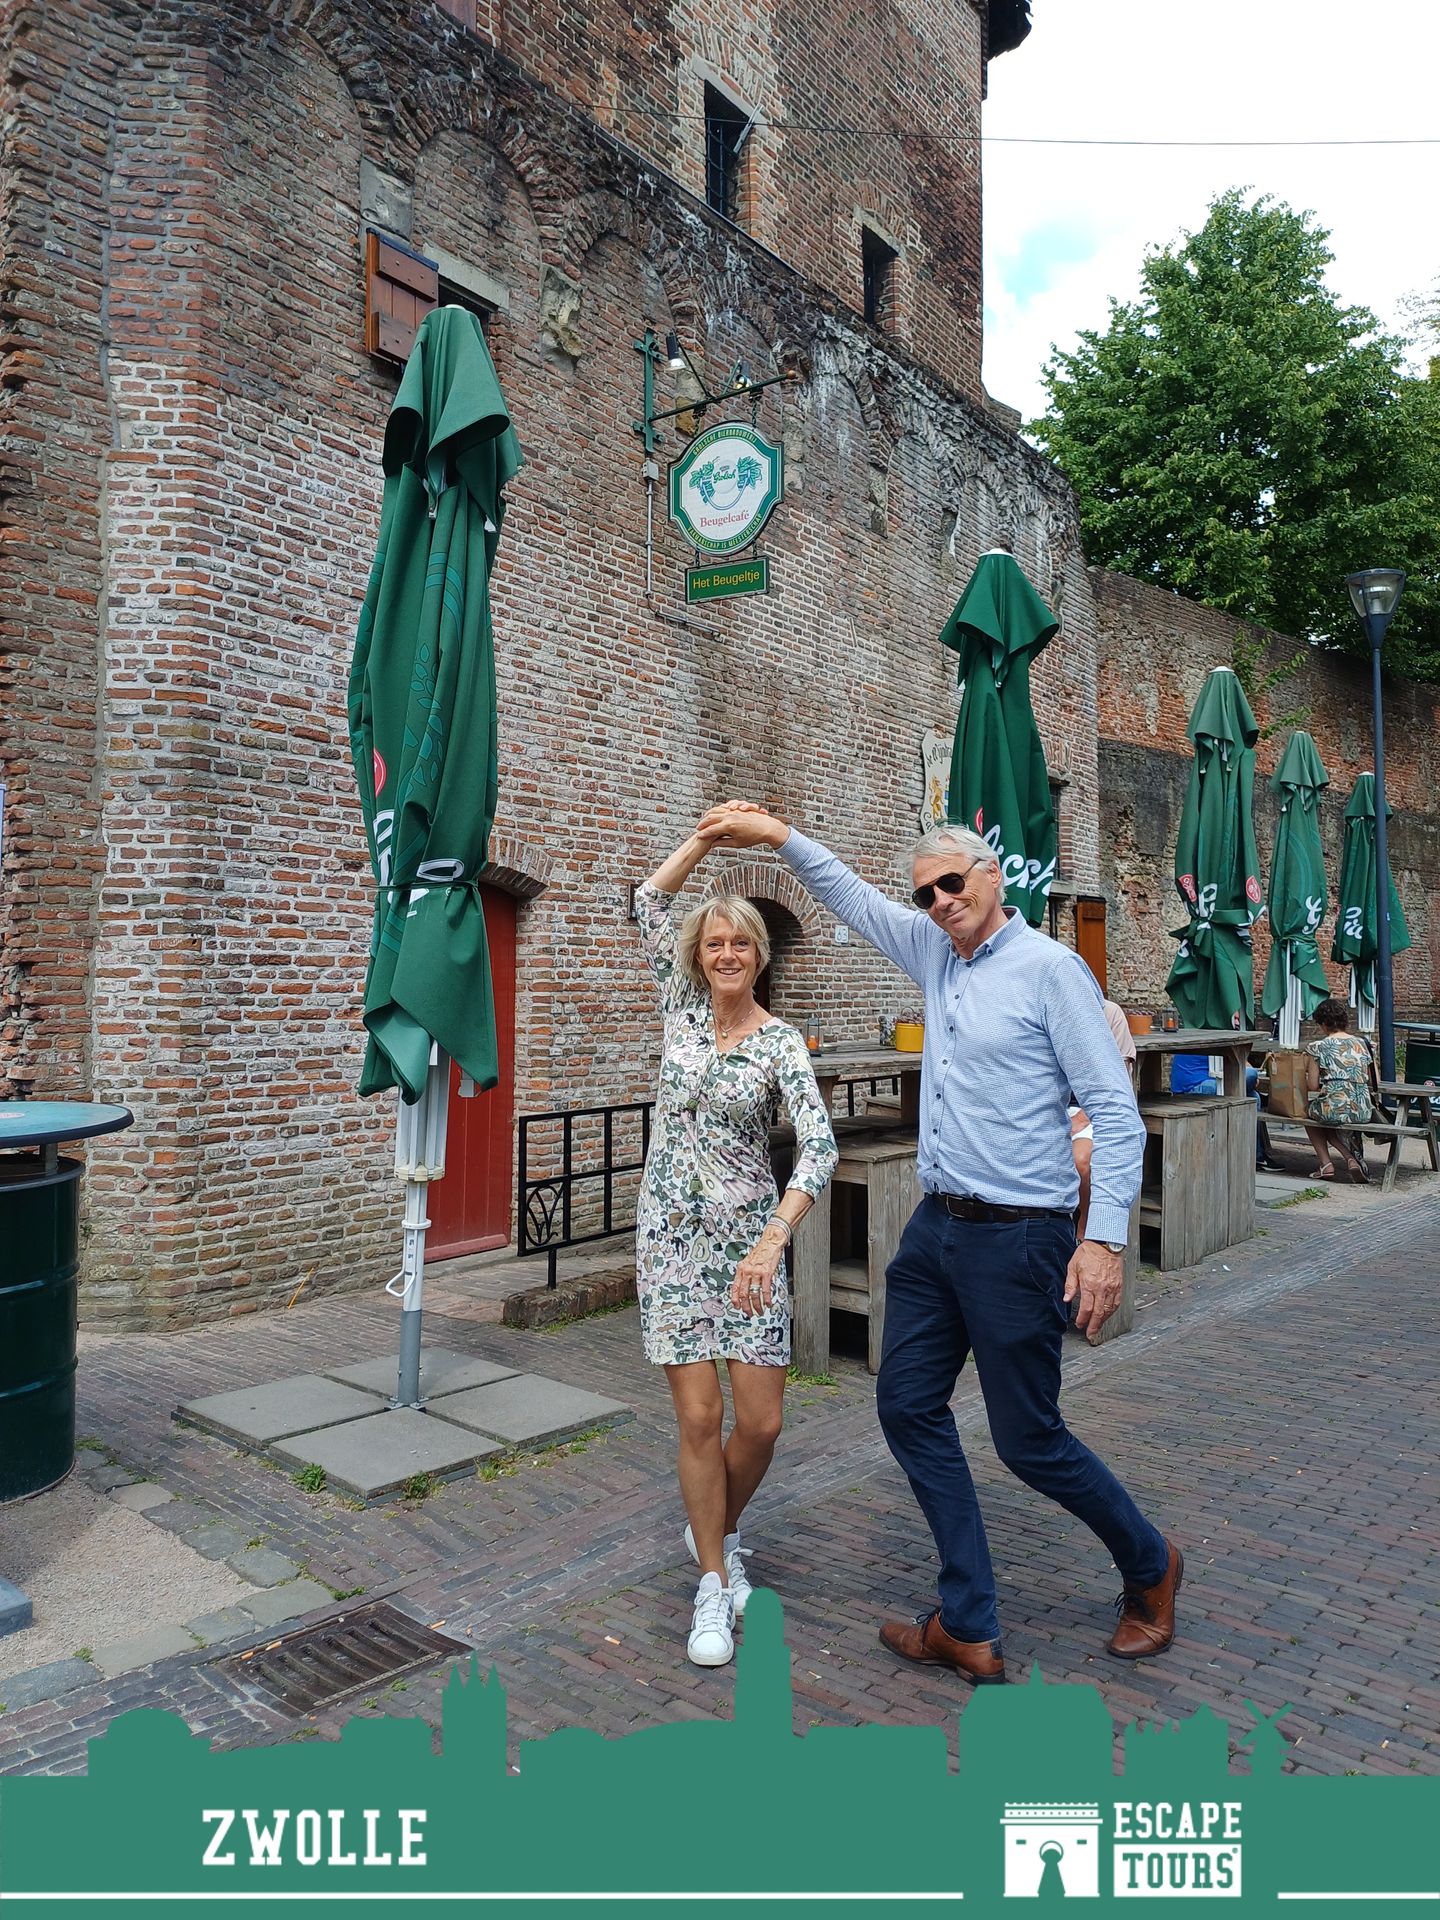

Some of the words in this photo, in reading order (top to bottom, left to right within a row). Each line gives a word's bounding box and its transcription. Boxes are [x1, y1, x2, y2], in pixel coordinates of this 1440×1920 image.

[700, 509, 750, 528] Beugelcafé
[692, 577, 710, 589] Het
[713, 569, 760, 586] Beugeltje
